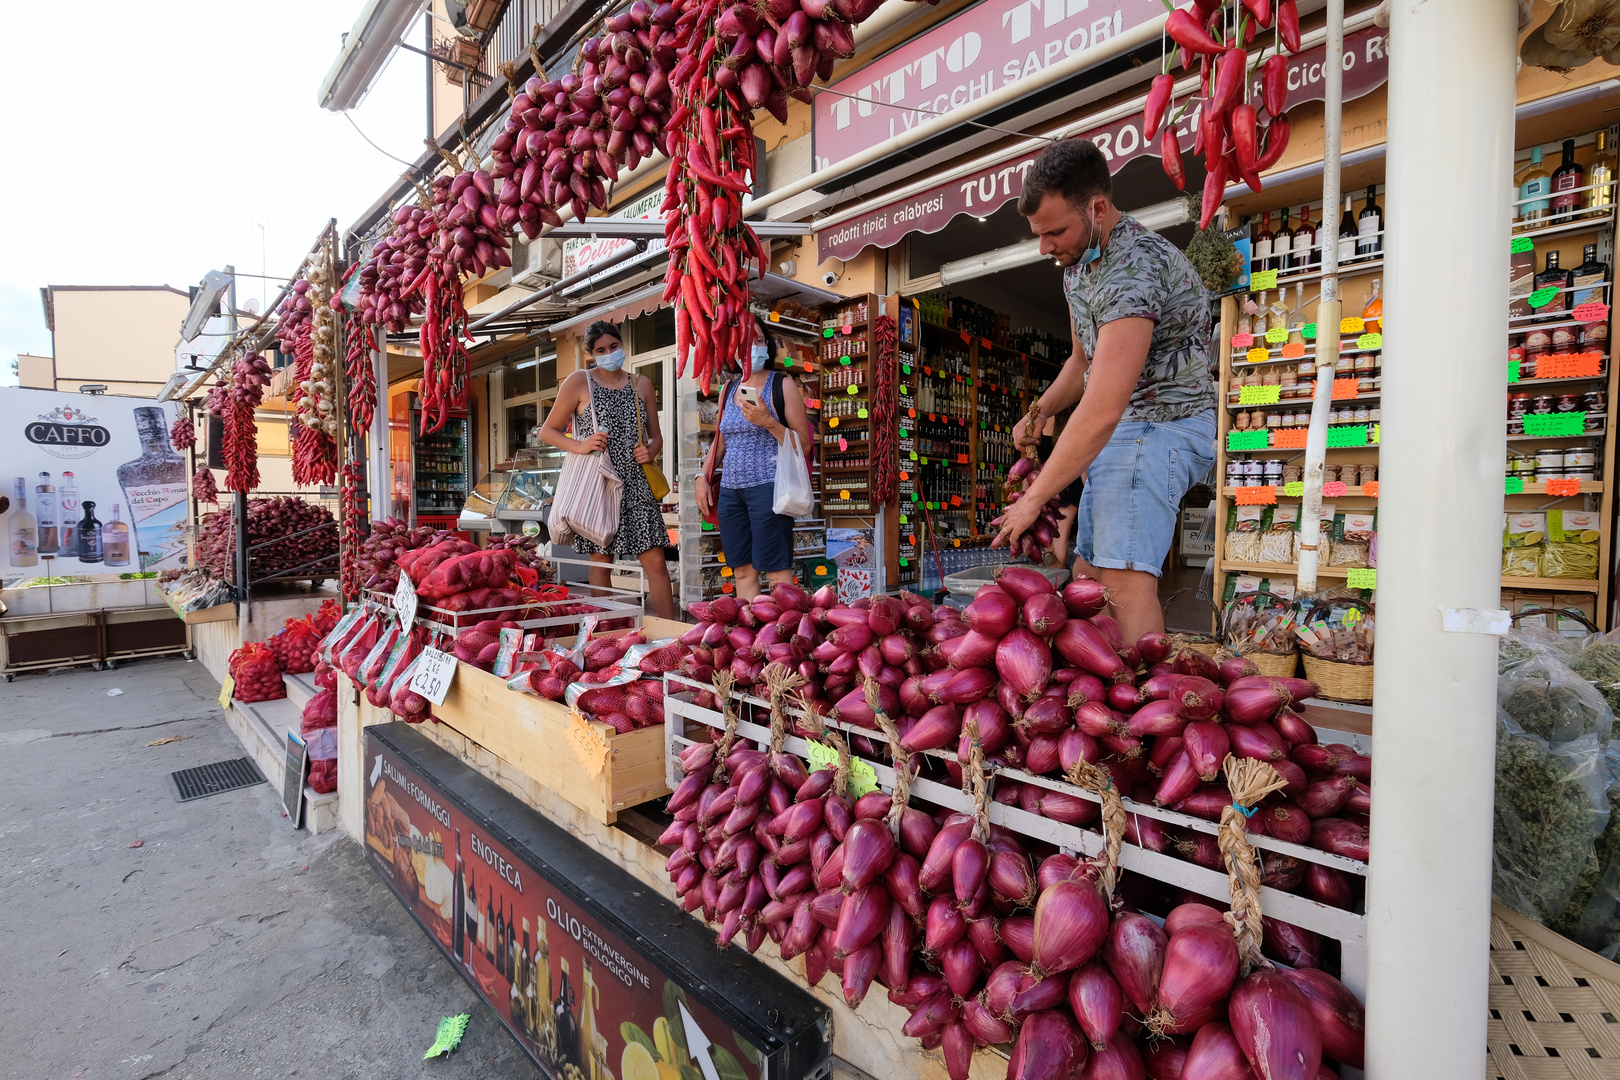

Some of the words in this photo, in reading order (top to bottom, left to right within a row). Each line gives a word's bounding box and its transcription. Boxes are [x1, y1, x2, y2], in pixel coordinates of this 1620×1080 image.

[830, 31, 982, 132] TUTTO
[902, 69, 994, 131] VECCHI
[1002, 9, 1123, 86] SAPORI
[960, 158, 1034, 208] TUTT
[863, 213, 887, 236] tipici
[893, 193, 944, 226] calabresi
[29, 424, 107, 445] CAFFO
[128, 488, 161, 497] Vecchio
[131, 496, 145, 505] del
[145, 496, 168, 504] Capo
[383, 760, 407, 791] SALUMI
[411, 782, 452, 830] FORMAGGI
[431, 840, 445, 858] 1973
[471, 832, 523, 893] ENOTECA
[546, 897, 582, 941] OLIO
[582, 924, 651, 990] EXTRAVERGINE
[582, 938, 633, 987] BIOLOGICO
